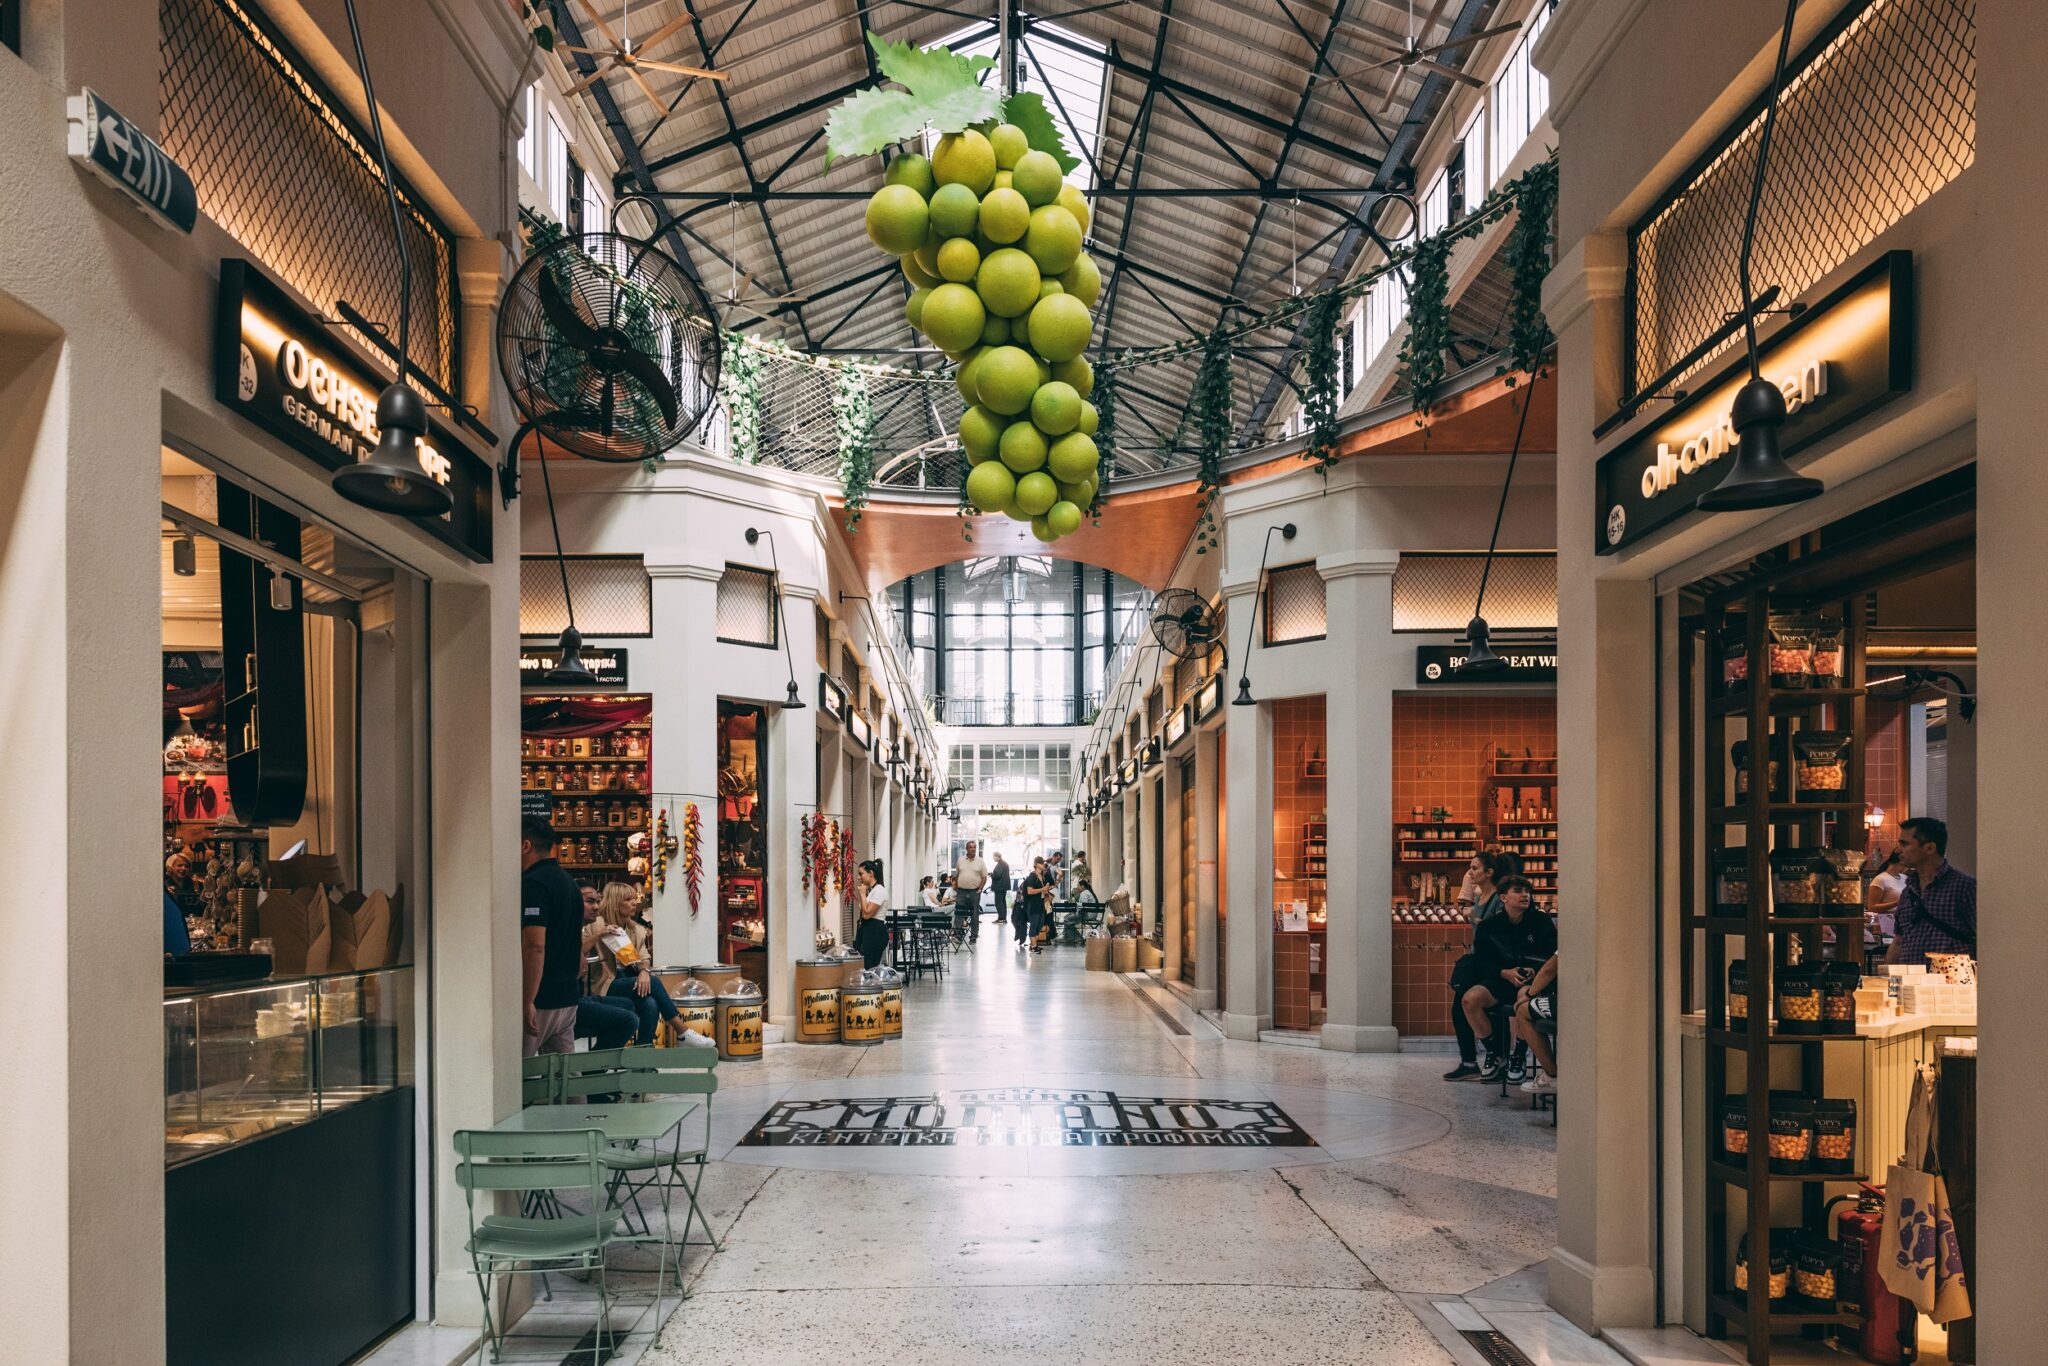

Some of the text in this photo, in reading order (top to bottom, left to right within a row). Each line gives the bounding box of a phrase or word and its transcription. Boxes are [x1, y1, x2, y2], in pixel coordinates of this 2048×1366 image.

[120, 119, 172, 210] EXIT
[282, 394, 354, 455] GERMAN
[1608, 520, 1624, 539] 15-16
[1510, 656, 1537, 668] EAT
[803, 989, 834, 1009] Modiano's
[845, 997, 874, 1014] Modiano's
[1537, 996, 1552, 1018] NIKE
[1772, 1118, 1799, 1127] POPY'S
[1815, 1119, 1841, 1127] POPY'S
